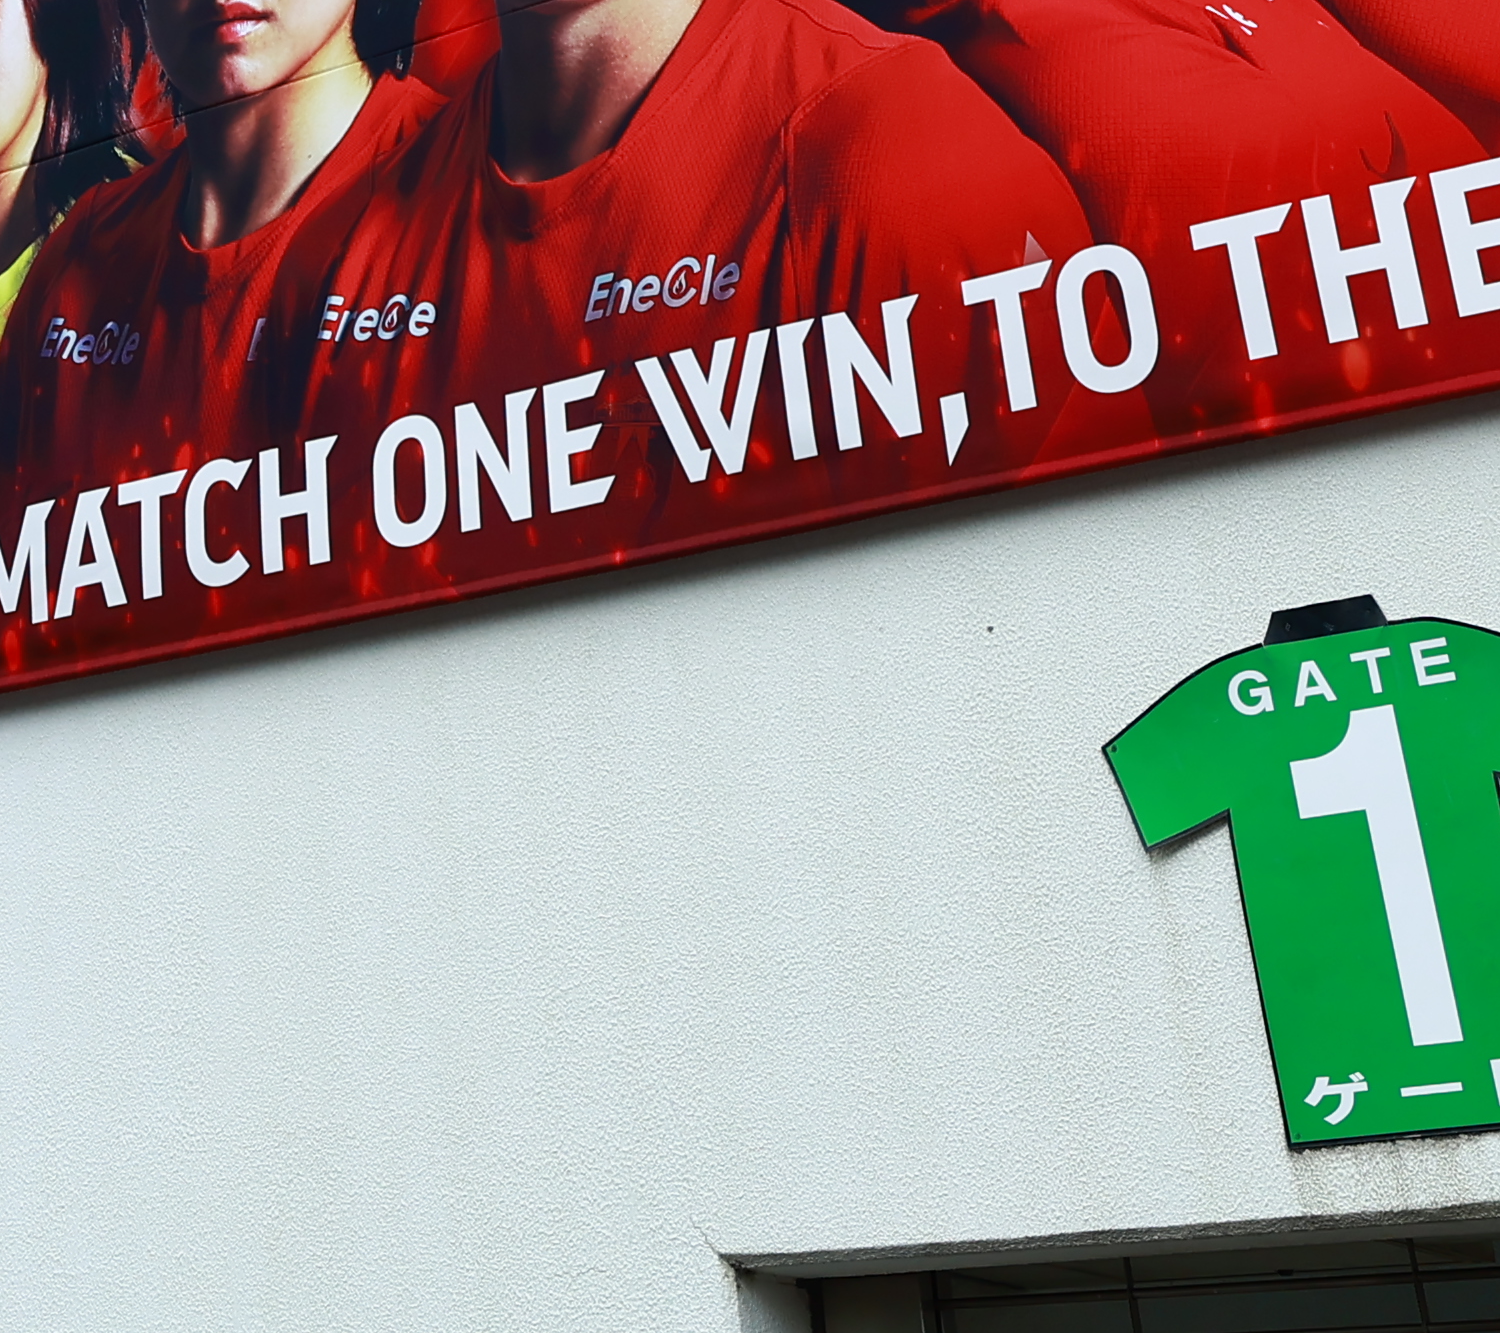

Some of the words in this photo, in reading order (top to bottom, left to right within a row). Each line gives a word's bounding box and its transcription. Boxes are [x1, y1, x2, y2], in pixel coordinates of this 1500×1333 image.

[584, 254, 740, 323] EneCle
[40, 317, 140, 365] EneCle
[372, 369, 619, 549] ONE
[961, 242, 1161, 414] TO
[1228, 637, 1457, 716] GATE
[1289, 704, 1465, 1047] 1
